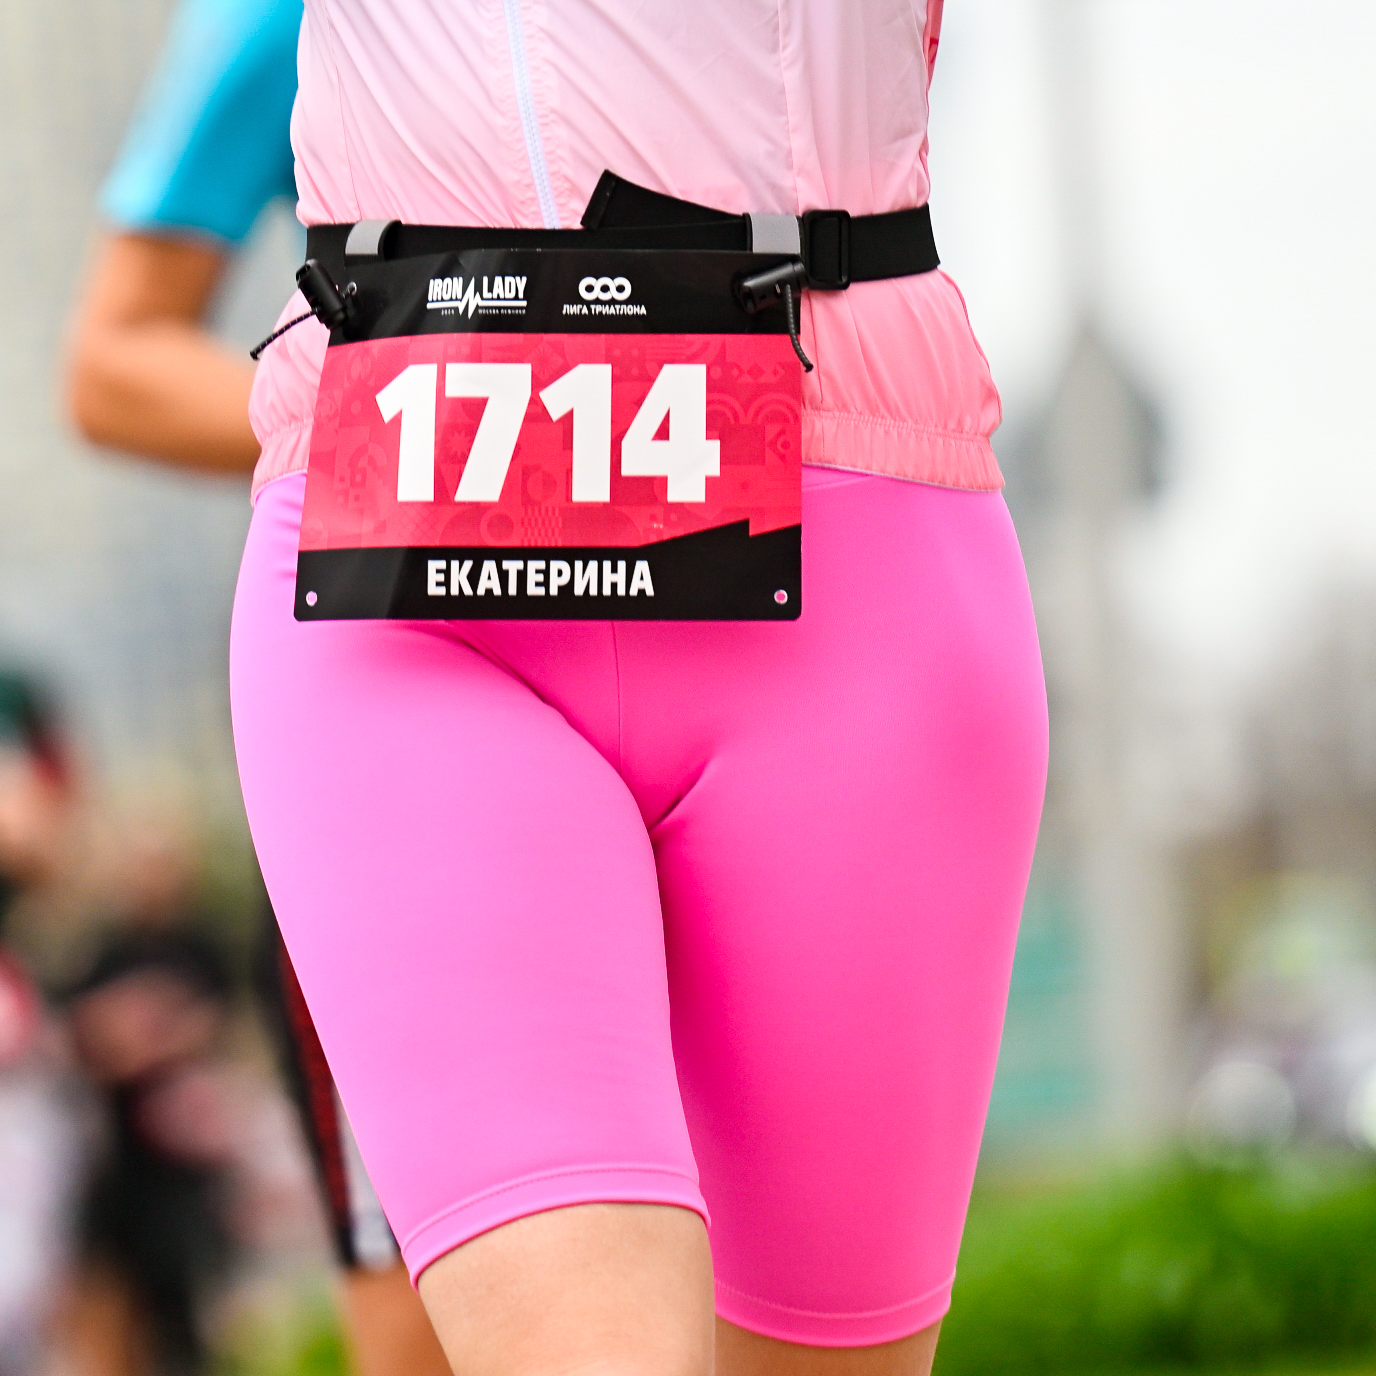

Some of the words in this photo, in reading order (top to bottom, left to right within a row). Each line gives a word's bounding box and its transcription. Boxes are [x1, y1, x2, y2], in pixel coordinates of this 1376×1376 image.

[427, 276, 464, 302] IRON
[482, 275, 528, 300] LADY
[562, 304, 588, 316] ЛИГА
[590, 304, 647, 316] ТРИАТЛОНА
[375, 363, 721, 503] 1714
[426, 559, 655, 598] ЕКАТЕРИНА
